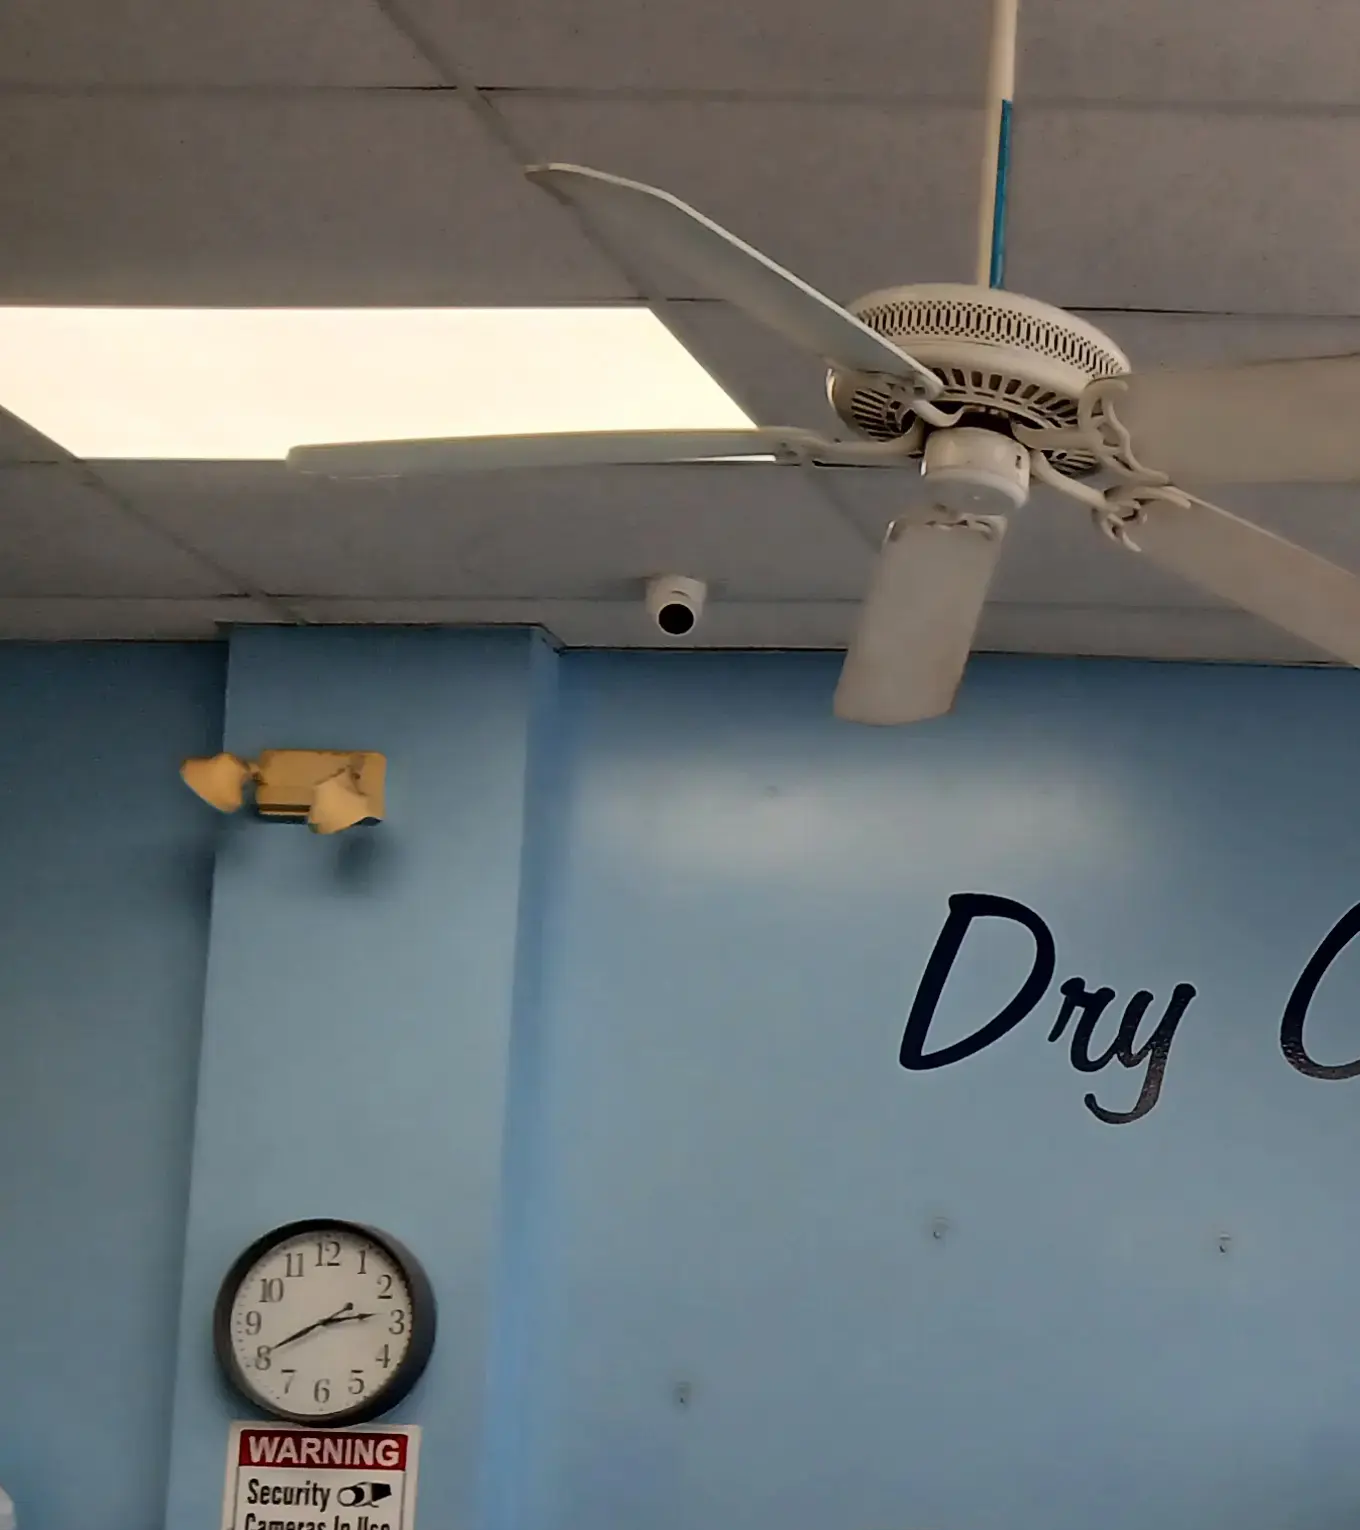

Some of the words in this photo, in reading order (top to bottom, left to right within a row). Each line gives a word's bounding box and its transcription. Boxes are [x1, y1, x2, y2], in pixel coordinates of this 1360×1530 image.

[898, 892, 1196, 1126] Dry
[285, 1252, 305, 1278] 11
[315, 1241, 341, 1267] 12
[356, 1250, 368, 1274] 1
[259, 1277, 284, 1303] 10
[376, 1274, 393, 1299] 2
[245, 1311, 262, 1335] 9
[389, 1309, 405, 1335] 3
[256, 1345, 272, 1370] 8
[375, 1343, 391, 1368] 4
[281, 1368, 297, 1394] 7
[314, 1378, 330, 1403] 6
[349, 1368, 365, 1394] 5
[248, 1435, 400, 1467] WARNING
[247, 1477, 331, 1512] Security
